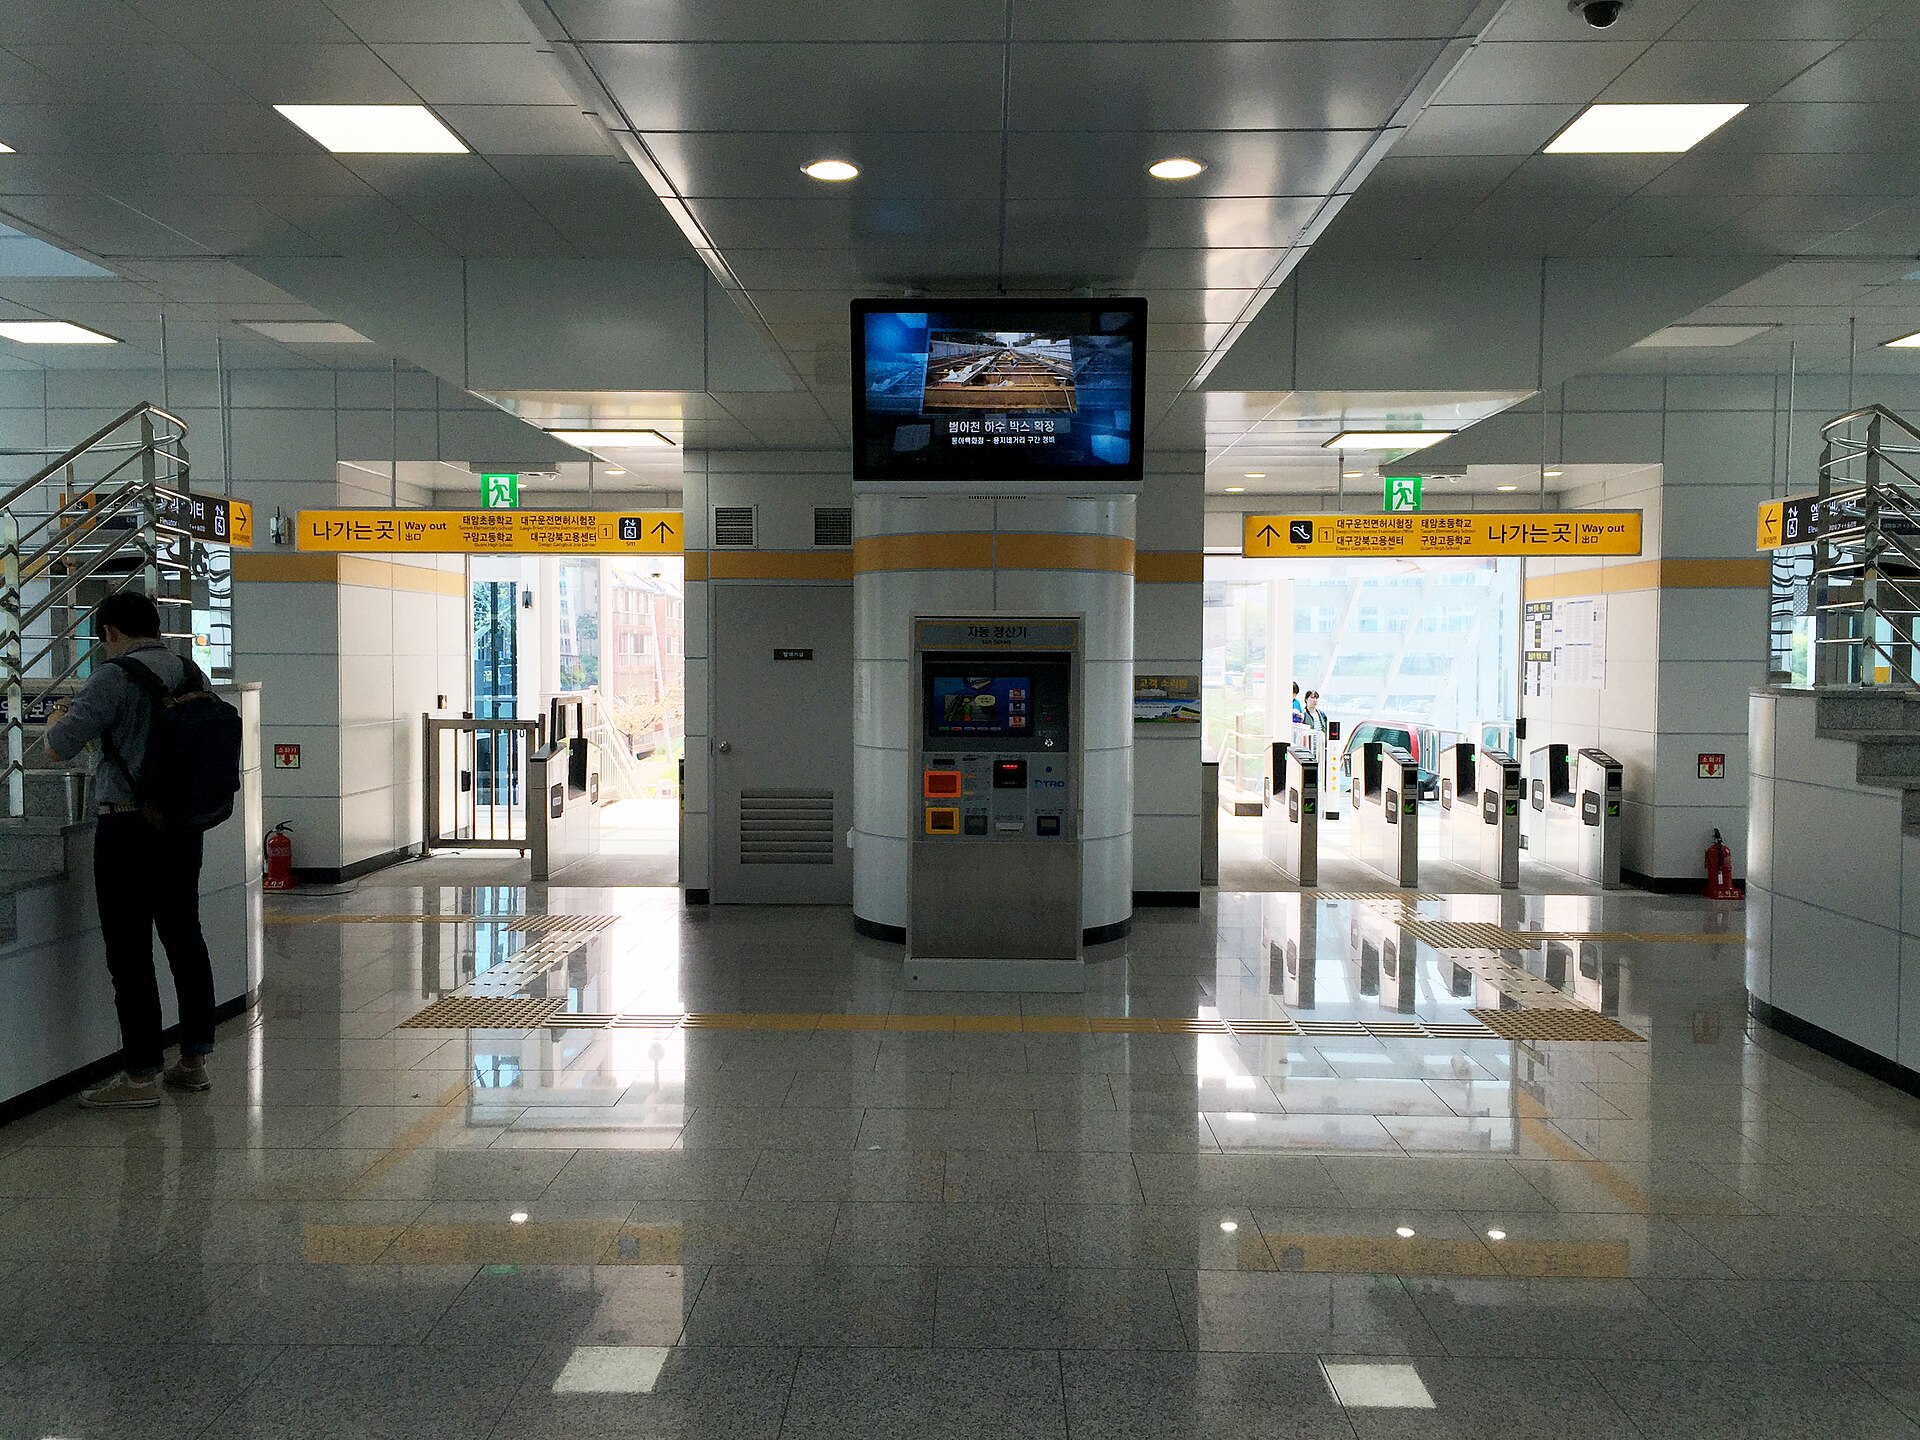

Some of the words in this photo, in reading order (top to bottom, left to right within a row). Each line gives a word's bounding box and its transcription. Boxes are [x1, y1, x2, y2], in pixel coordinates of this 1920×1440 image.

[948, 421, 980, 433] 범어천
[984, 421, 1005, 433] 하수
[1009, 421, 1030, 433] 박스
[1033, 420, 1055, 433] 확장
[1027, 436, 1040, 444] 구간
[462, 515, 513, 526] 태암초등학교
[520, 515, 596, 526] 대구운전면허시험장
[1335, 518, 1413, 529] 대구운전면허시험장
[1421, 518, 1472, 529] 태암초등학교
[313, 520, 395, 541] 나가는곳
[404, 521, 426, 532] Way
[429, 521, 447, 531] out
[1581, 524, 1604, 535] Way
[1606, 524, 1625, 533] out
[405, 533, 422, 541] 出口
[463, 532, 513, 542] 구암고등학교
[530, 532, 597, 543] 대구강북고용센터
[1488, 523, 1571, 544] 나가는곳
[1335, 535, 1404, 546] 대구강북고용센터
[1420, 535, 1472, 546] 구암고등학교
[1581, 536, 1598, 544] 出口
[967, 626, 990, 638] 자동
[993, 626, 1027, 638] 정산기
